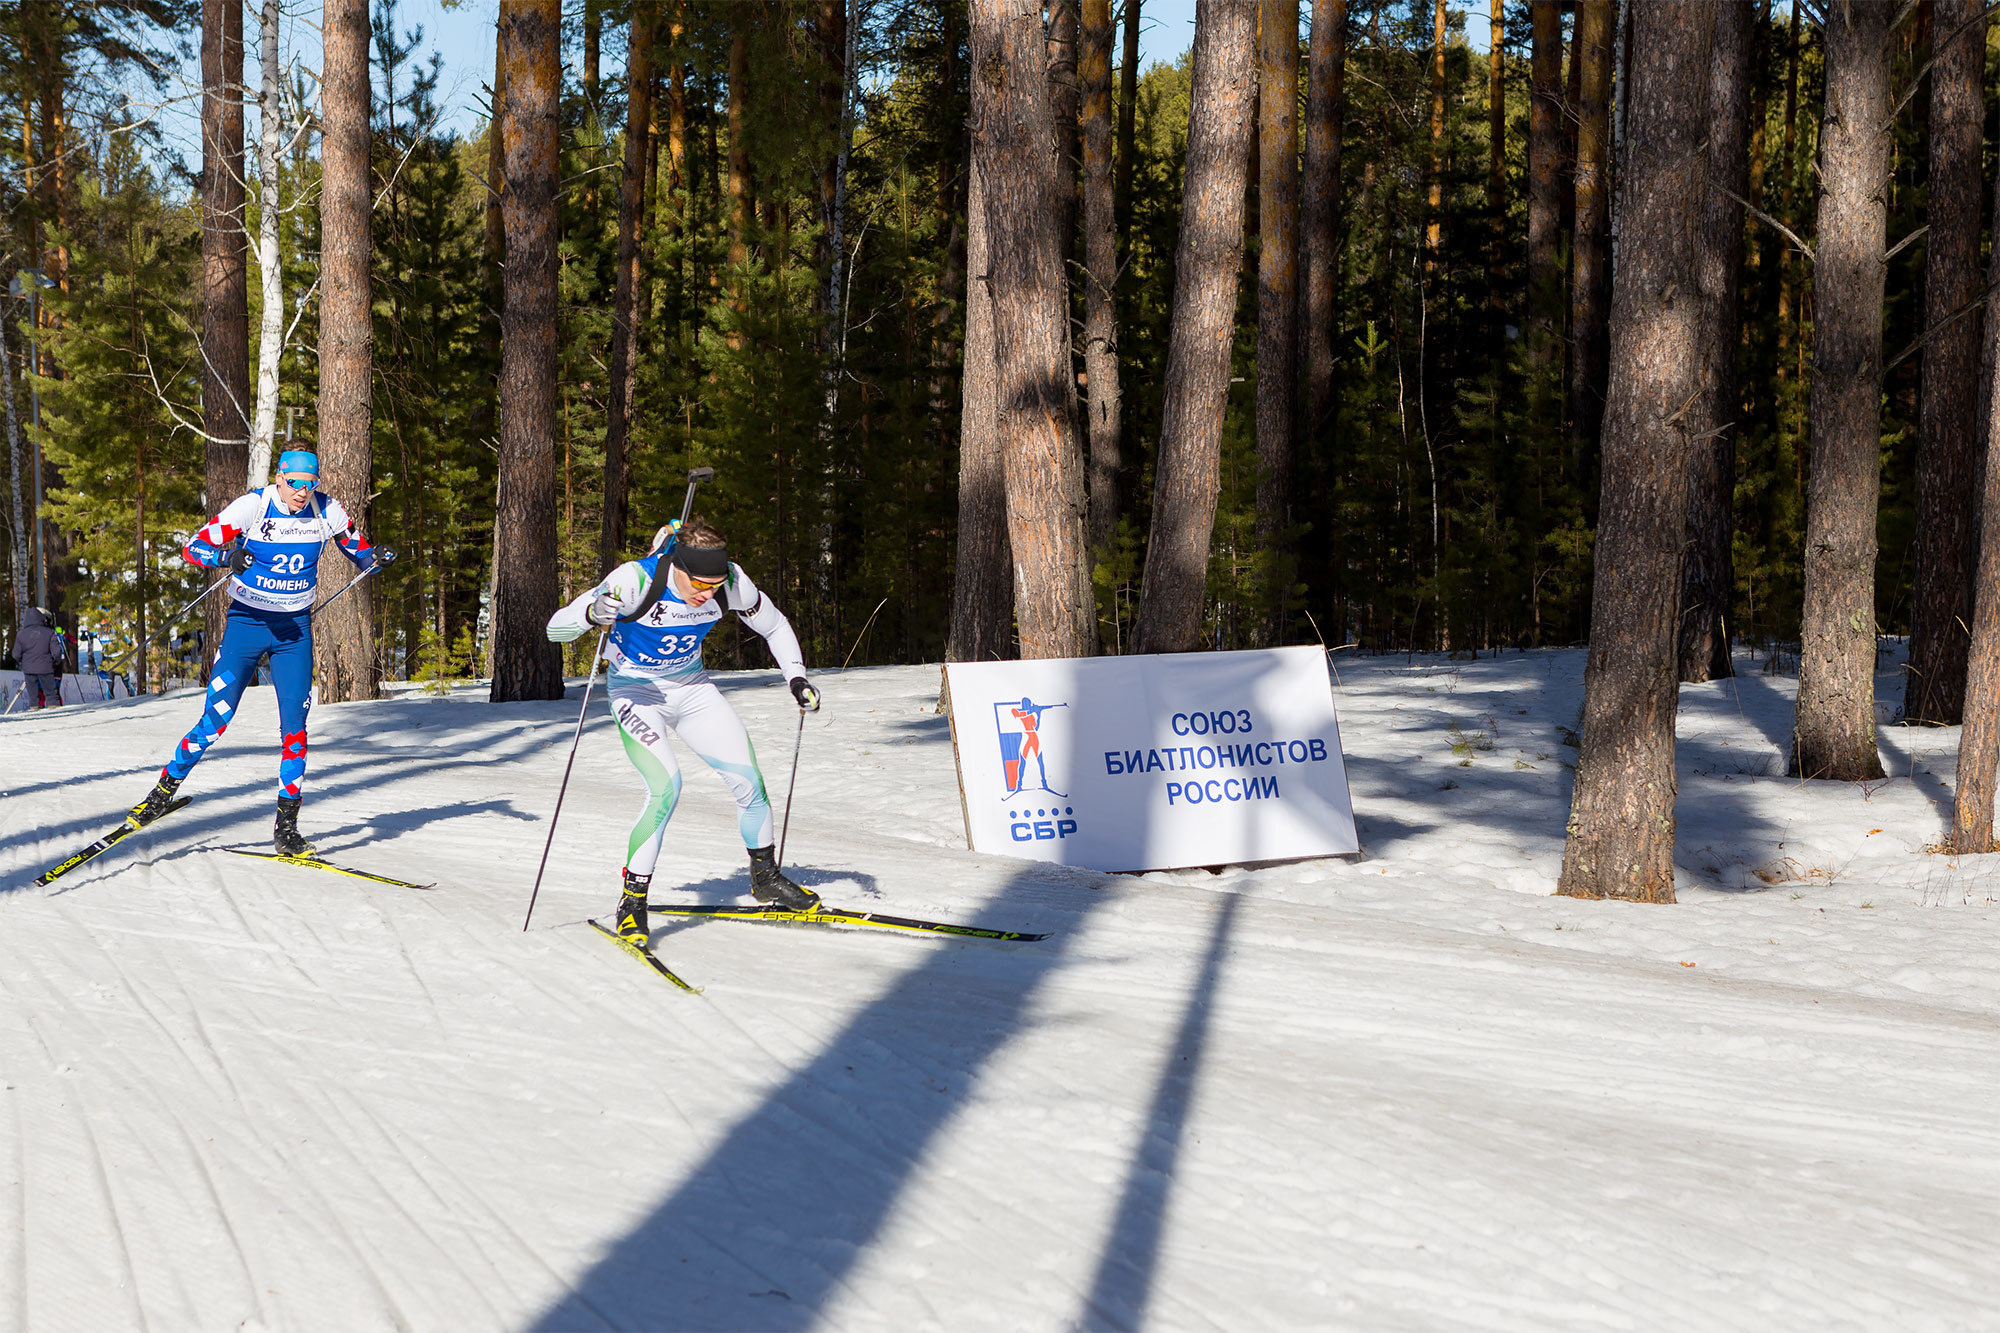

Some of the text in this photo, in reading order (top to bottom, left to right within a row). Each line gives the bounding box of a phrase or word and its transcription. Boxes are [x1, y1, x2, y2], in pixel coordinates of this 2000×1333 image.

[270, 553, 305, 575] 20
[255, 574, 310, 591] ТЮМЕНЬ
[657, 634, 698, 656] 33
[1171, 709, 1253, 736] СОЮЗ
[1104, 738, 1328, 775] БИАТЛОНИСТОВ
[1166, 775, 1280, 806] РОССИИ
[1010, 818, 1078, 842] СБР
[277, 856, 323, 870] FISCHER
[762, 913, 847, 924] FISCHER
